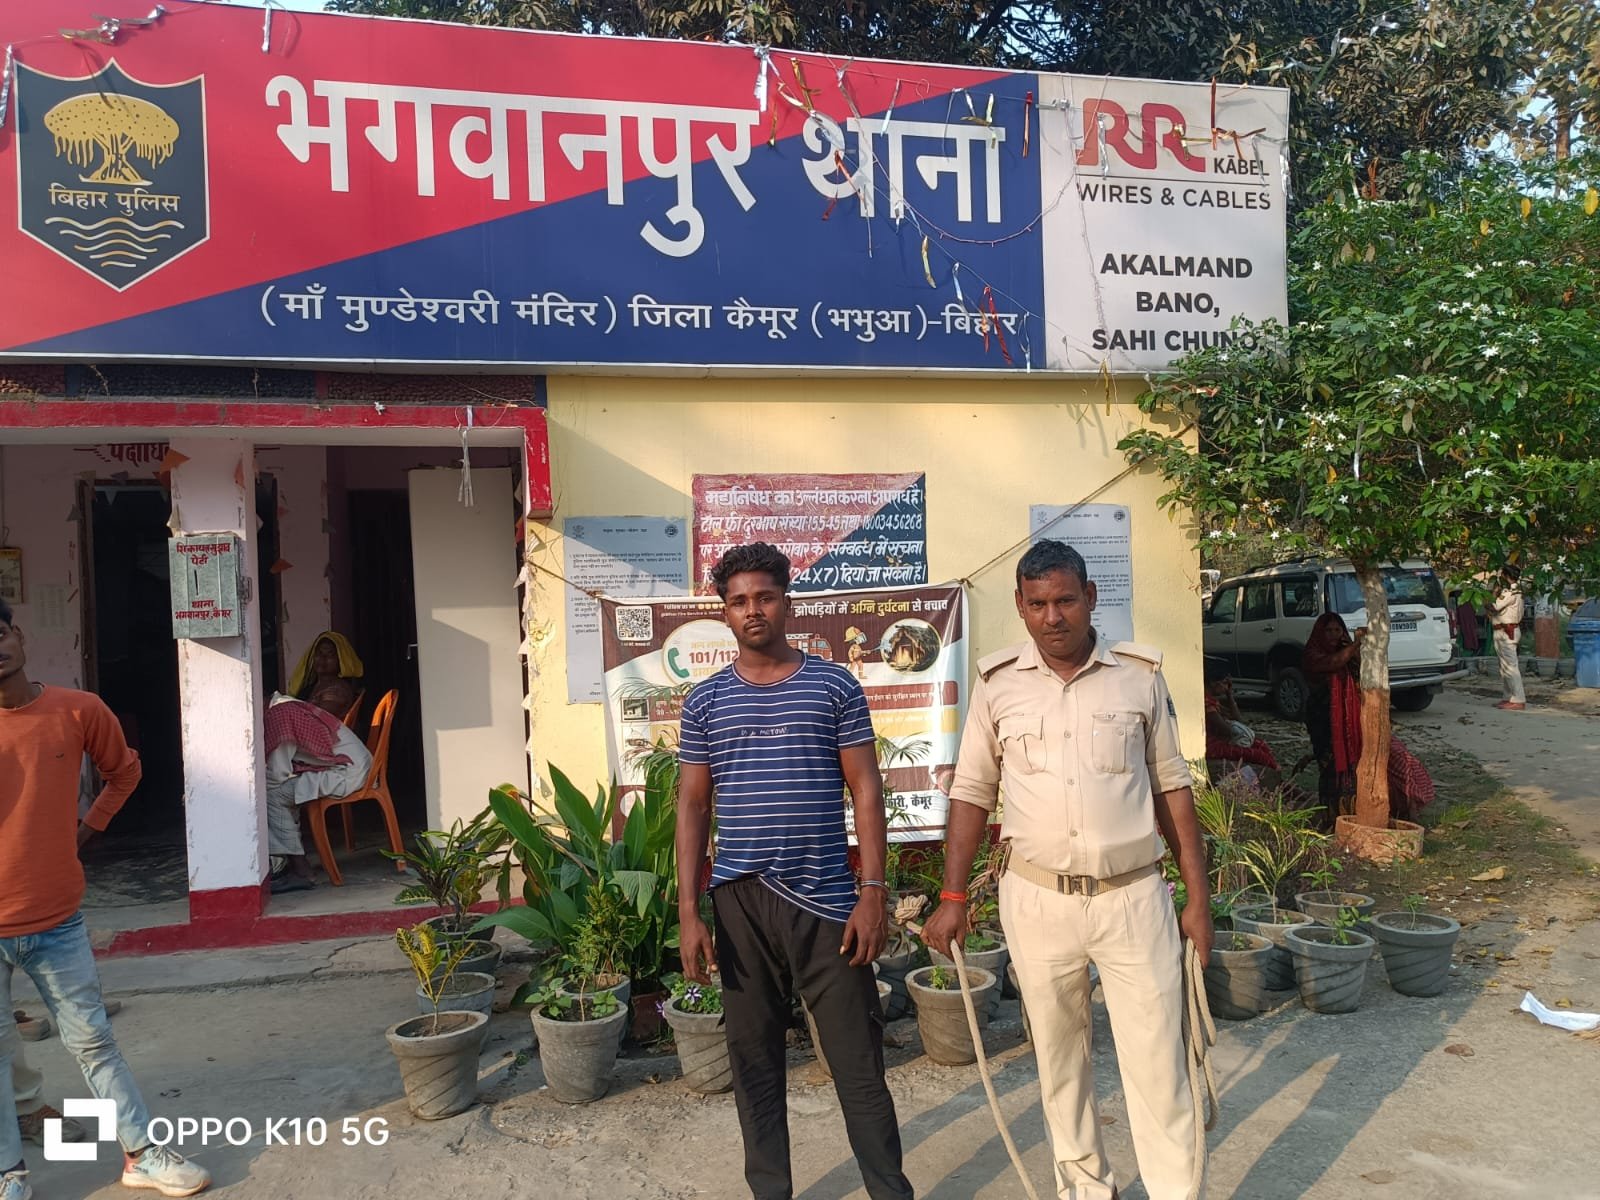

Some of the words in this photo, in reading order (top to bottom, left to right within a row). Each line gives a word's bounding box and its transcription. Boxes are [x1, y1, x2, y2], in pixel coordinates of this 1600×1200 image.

[1075, 98, 1206, 173] RR
[265, 75, 760, 257] भगवानपुर
[801, 111, 1006, 223] थाना
[48, 182, 109, 209] बिहार
[115, 187, 181, 217] पुलिस
[1076, 183, 1152, 205] WIRES
[1160, 187, 1175, 206] &
[1183, 189, 1271, 210] CABLES
[1100, 253, 1253, 279] AKALMAND
[336, 288, 500, 333] मुण्डेश्वरी
[627, 293, 712, 329] जिला
[722, 297, 800, 340] कैमूर
[1136, 291, 1220, 318] BANO,
[1092, 329, 1156, 351] SAHI
[794, 601, 837, 618] झोपड़ियों
[837, 600, 848, 615] में
[850, 599, 875, 615] अग्नि
[877, 599, 910, 617] दुर्घटना
[912, 598, 922, 612] से
[923, 599, 948, 611] बचाव
[689, 649, 738, 666] 101/112
